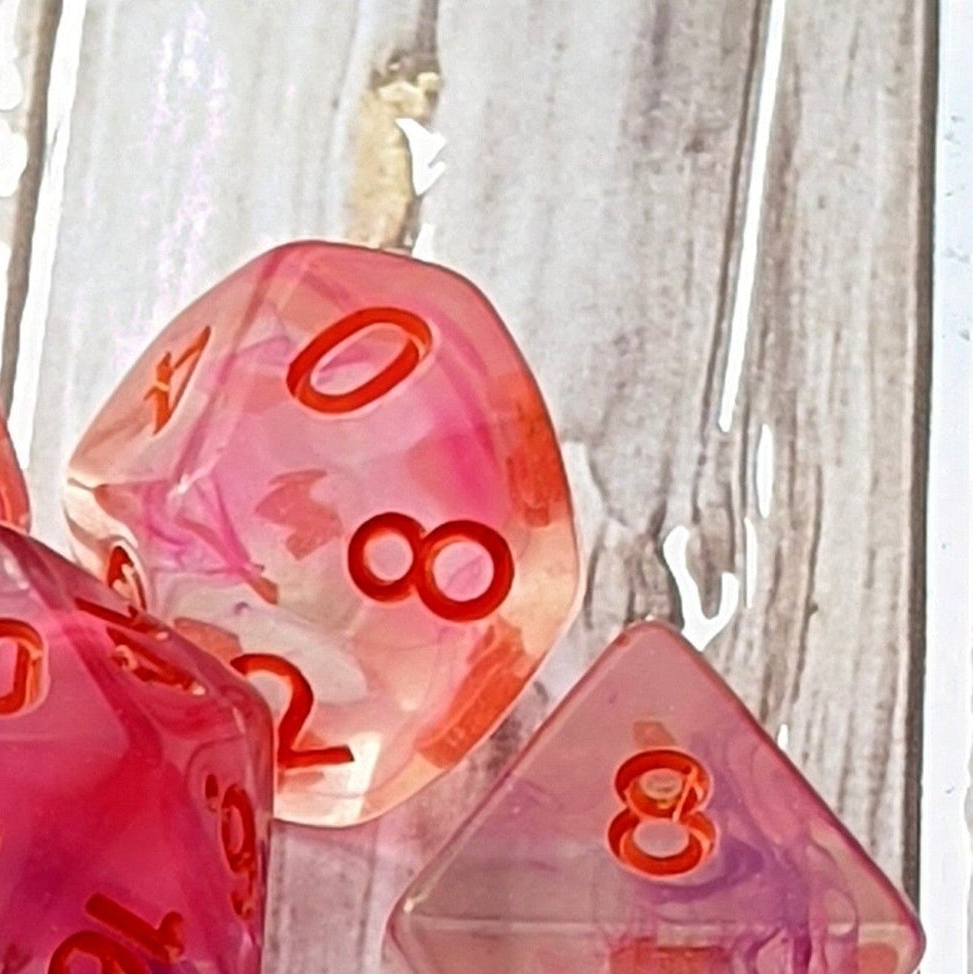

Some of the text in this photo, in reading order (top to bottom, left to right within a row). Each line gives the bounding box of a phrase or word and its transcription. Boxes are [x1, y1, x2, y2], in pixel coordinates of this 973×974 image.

[286, 306, 433, 414] 0
[348, 511, 515, 622] 8
[230, 653, 355, 770] 2
[609, 749, 717, 878] 8
